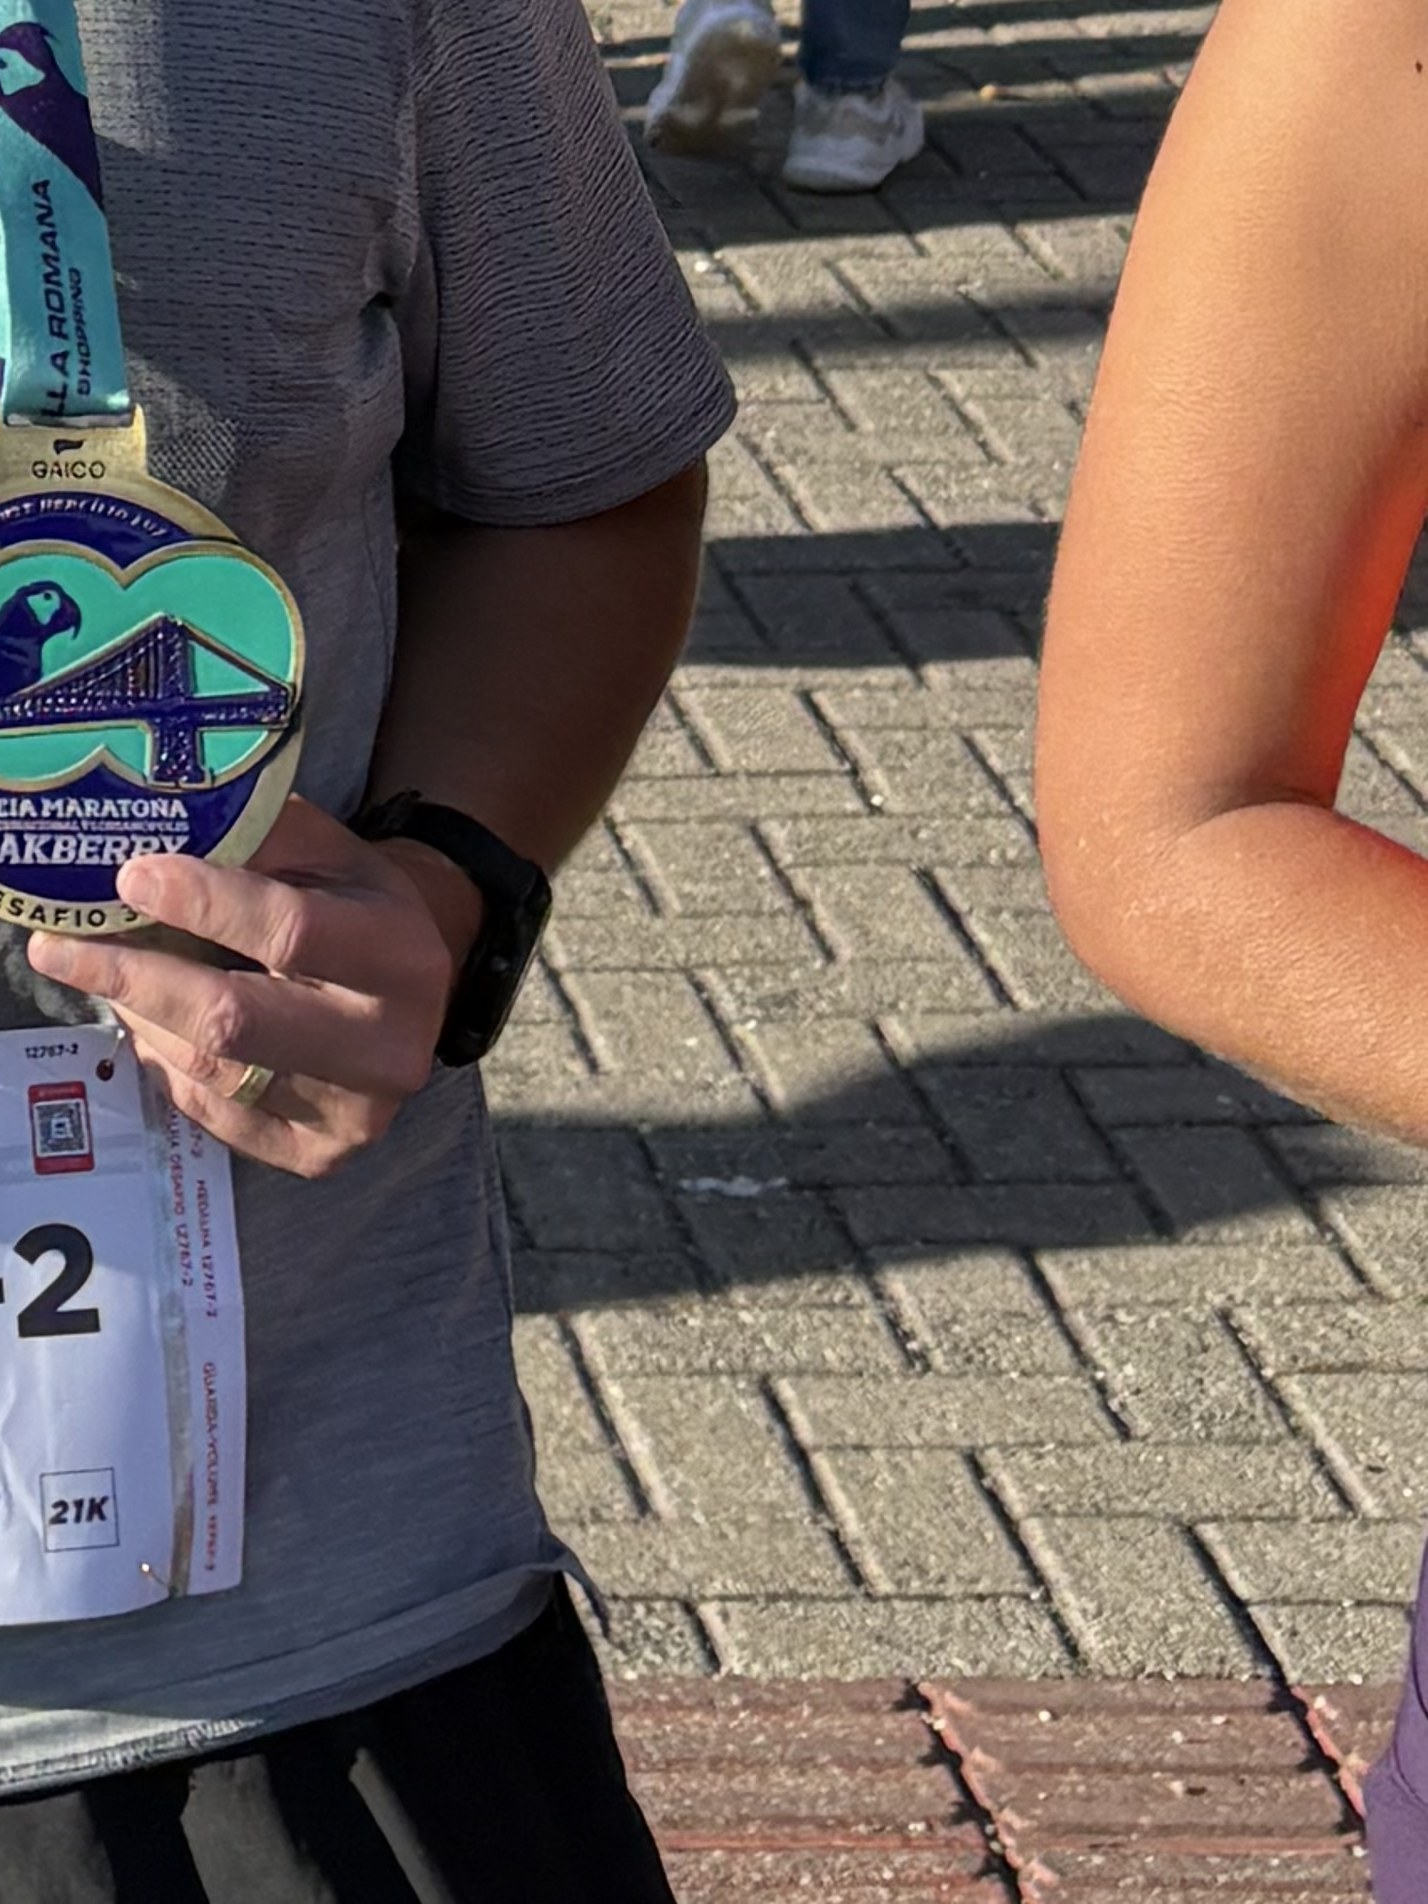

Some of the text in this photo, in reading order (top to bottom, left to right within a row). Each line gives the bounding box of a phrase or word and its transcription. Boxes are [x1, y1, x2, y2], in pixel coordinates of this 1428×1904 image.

[31, 178, 69, 341] ROMANA
[31, 460, 107, 480] GAICO
[41, 796, 189, 819] MARATONA
[48, 1494, 110, 1527] 21K
